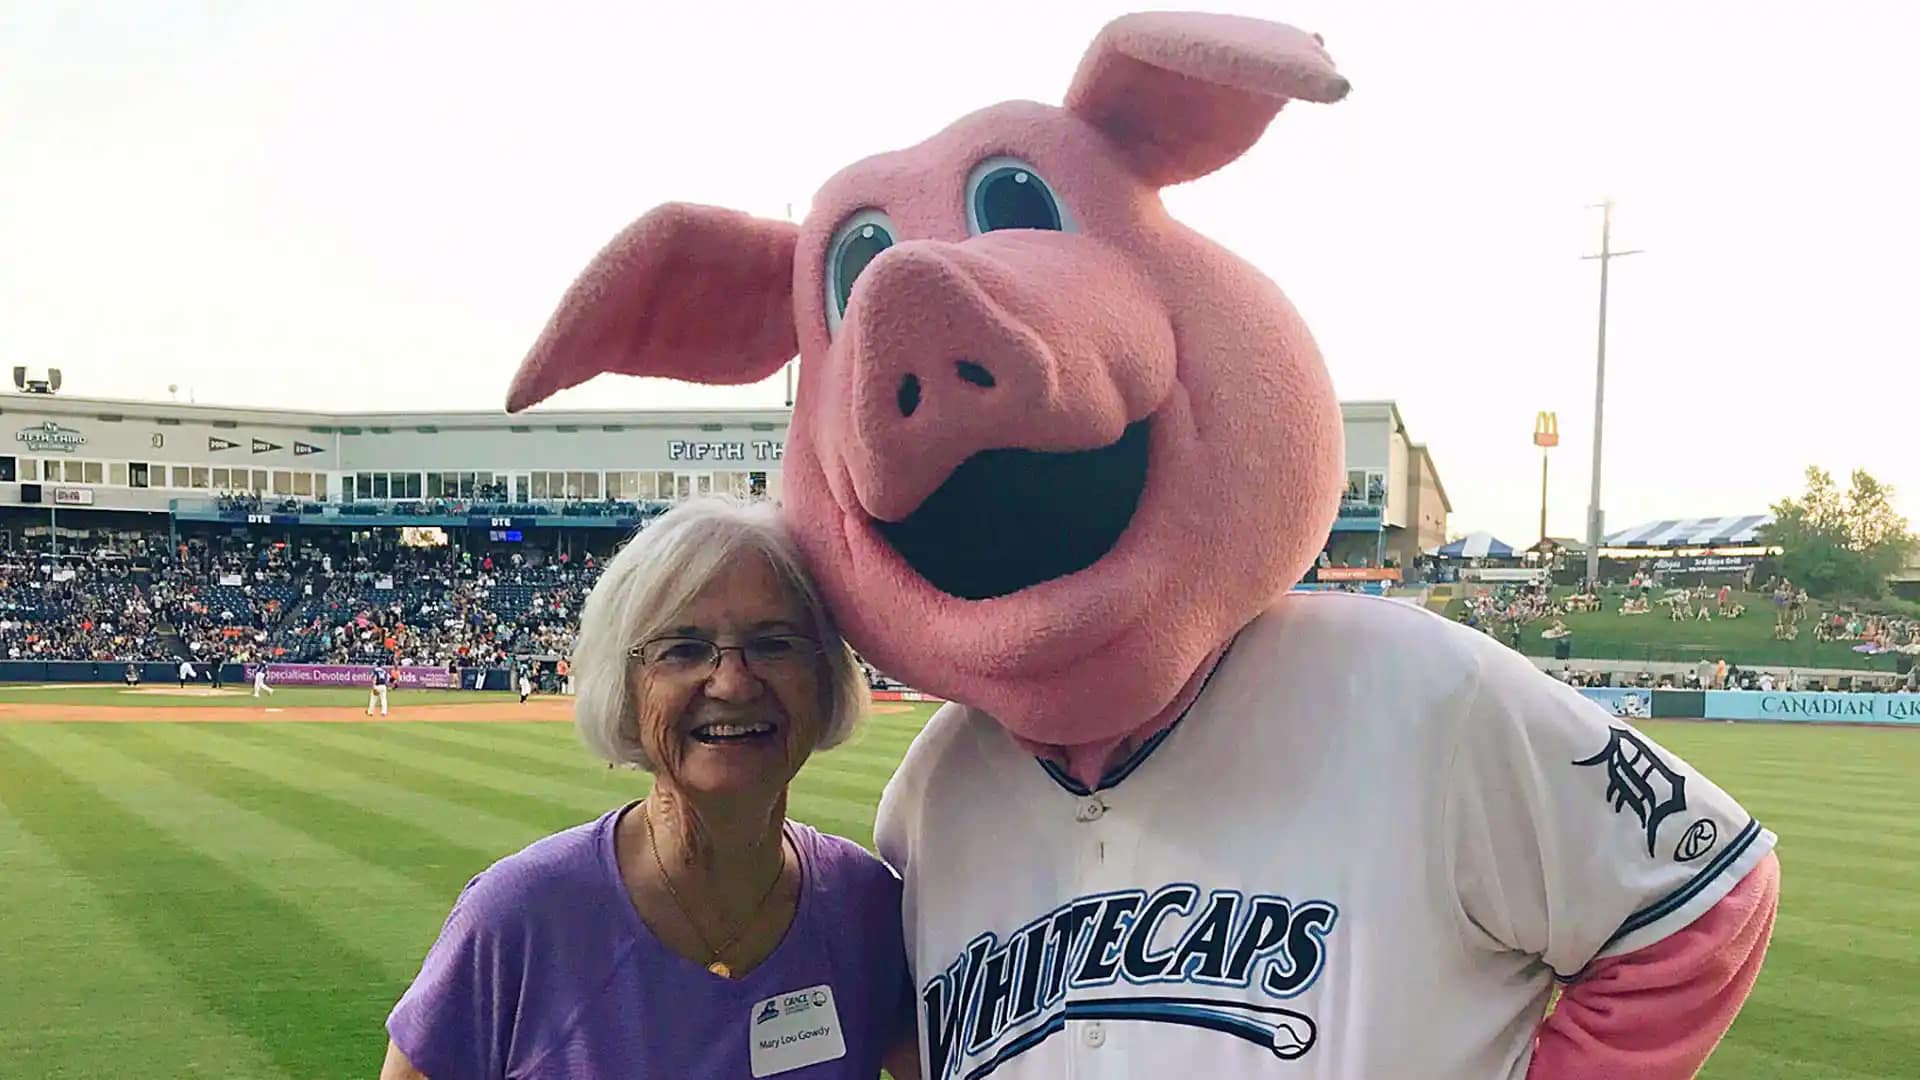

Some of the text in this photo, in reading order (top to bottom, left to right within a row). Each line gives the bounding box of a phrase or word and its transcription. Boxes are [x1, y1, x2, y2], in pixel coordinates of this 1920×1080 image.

[667, 440, 744, 460] FIFTH
[248, 515, 271, 523] DTE
[491, 517, 512, 526] DTE
[313, 670, 350, 681] Devoted
[1761, 696, 1875, 717] CANADIAN
[922, 883, 1340, 1080] WHITECAPS
[759, 1026, 831, 1049] Mary Lou Gowdy
